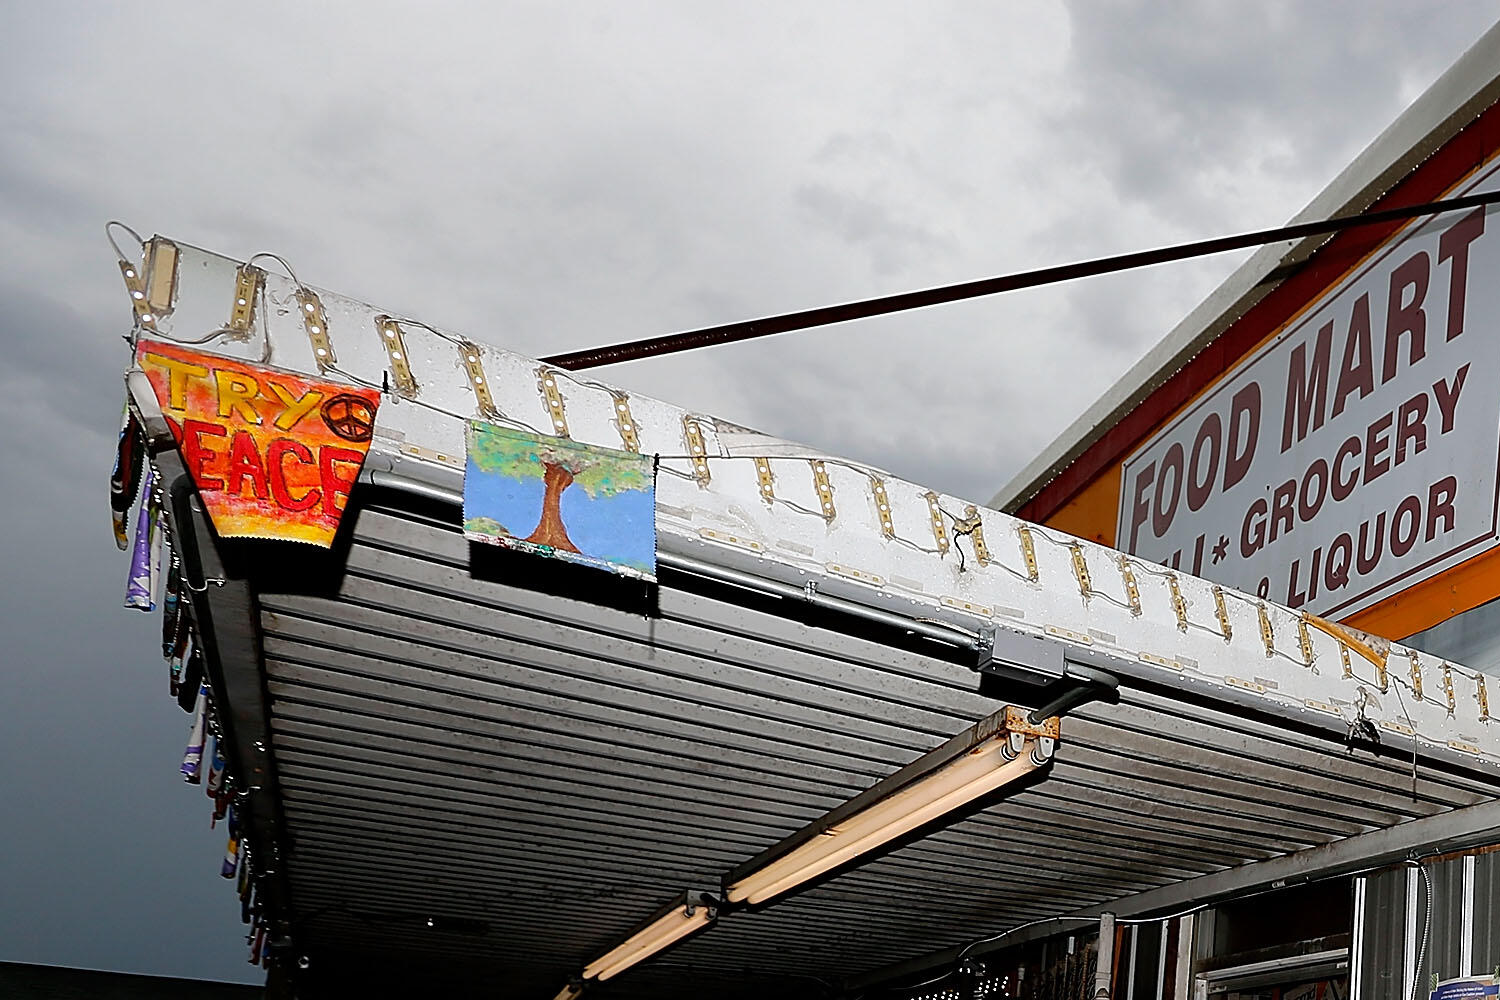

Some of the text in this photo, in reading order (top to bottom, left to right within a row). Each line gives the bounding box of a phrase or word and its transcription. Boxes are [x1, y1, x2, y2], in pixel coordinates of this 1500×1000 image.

[145, 352, 324, 432] TRY
[1130, 204, 1486, 555] FOOD MART
[1241, 362, 1471, 559] GROCERY
[1288, 475, 1458, 609] LIQUOR
